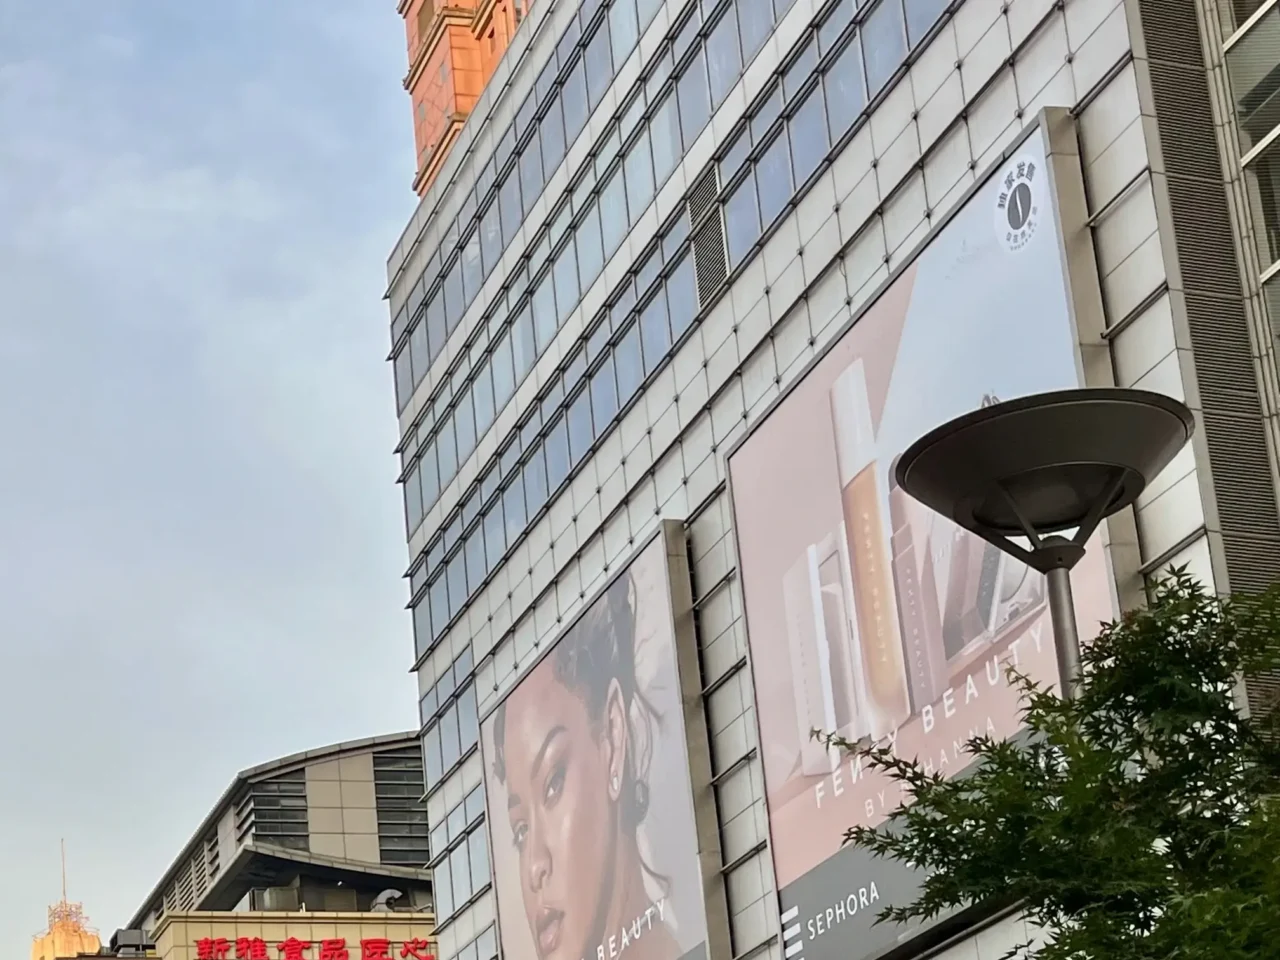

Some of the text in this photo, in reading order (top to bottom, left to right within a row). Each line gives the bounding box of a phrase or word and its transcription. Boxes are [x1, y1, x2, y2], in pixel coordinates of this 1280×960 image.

[815, 622, 1044, 809] FENY BEAUTY
[864, 790, 886, 818] BY
[807, 881, 880, 941] SEPHORA
